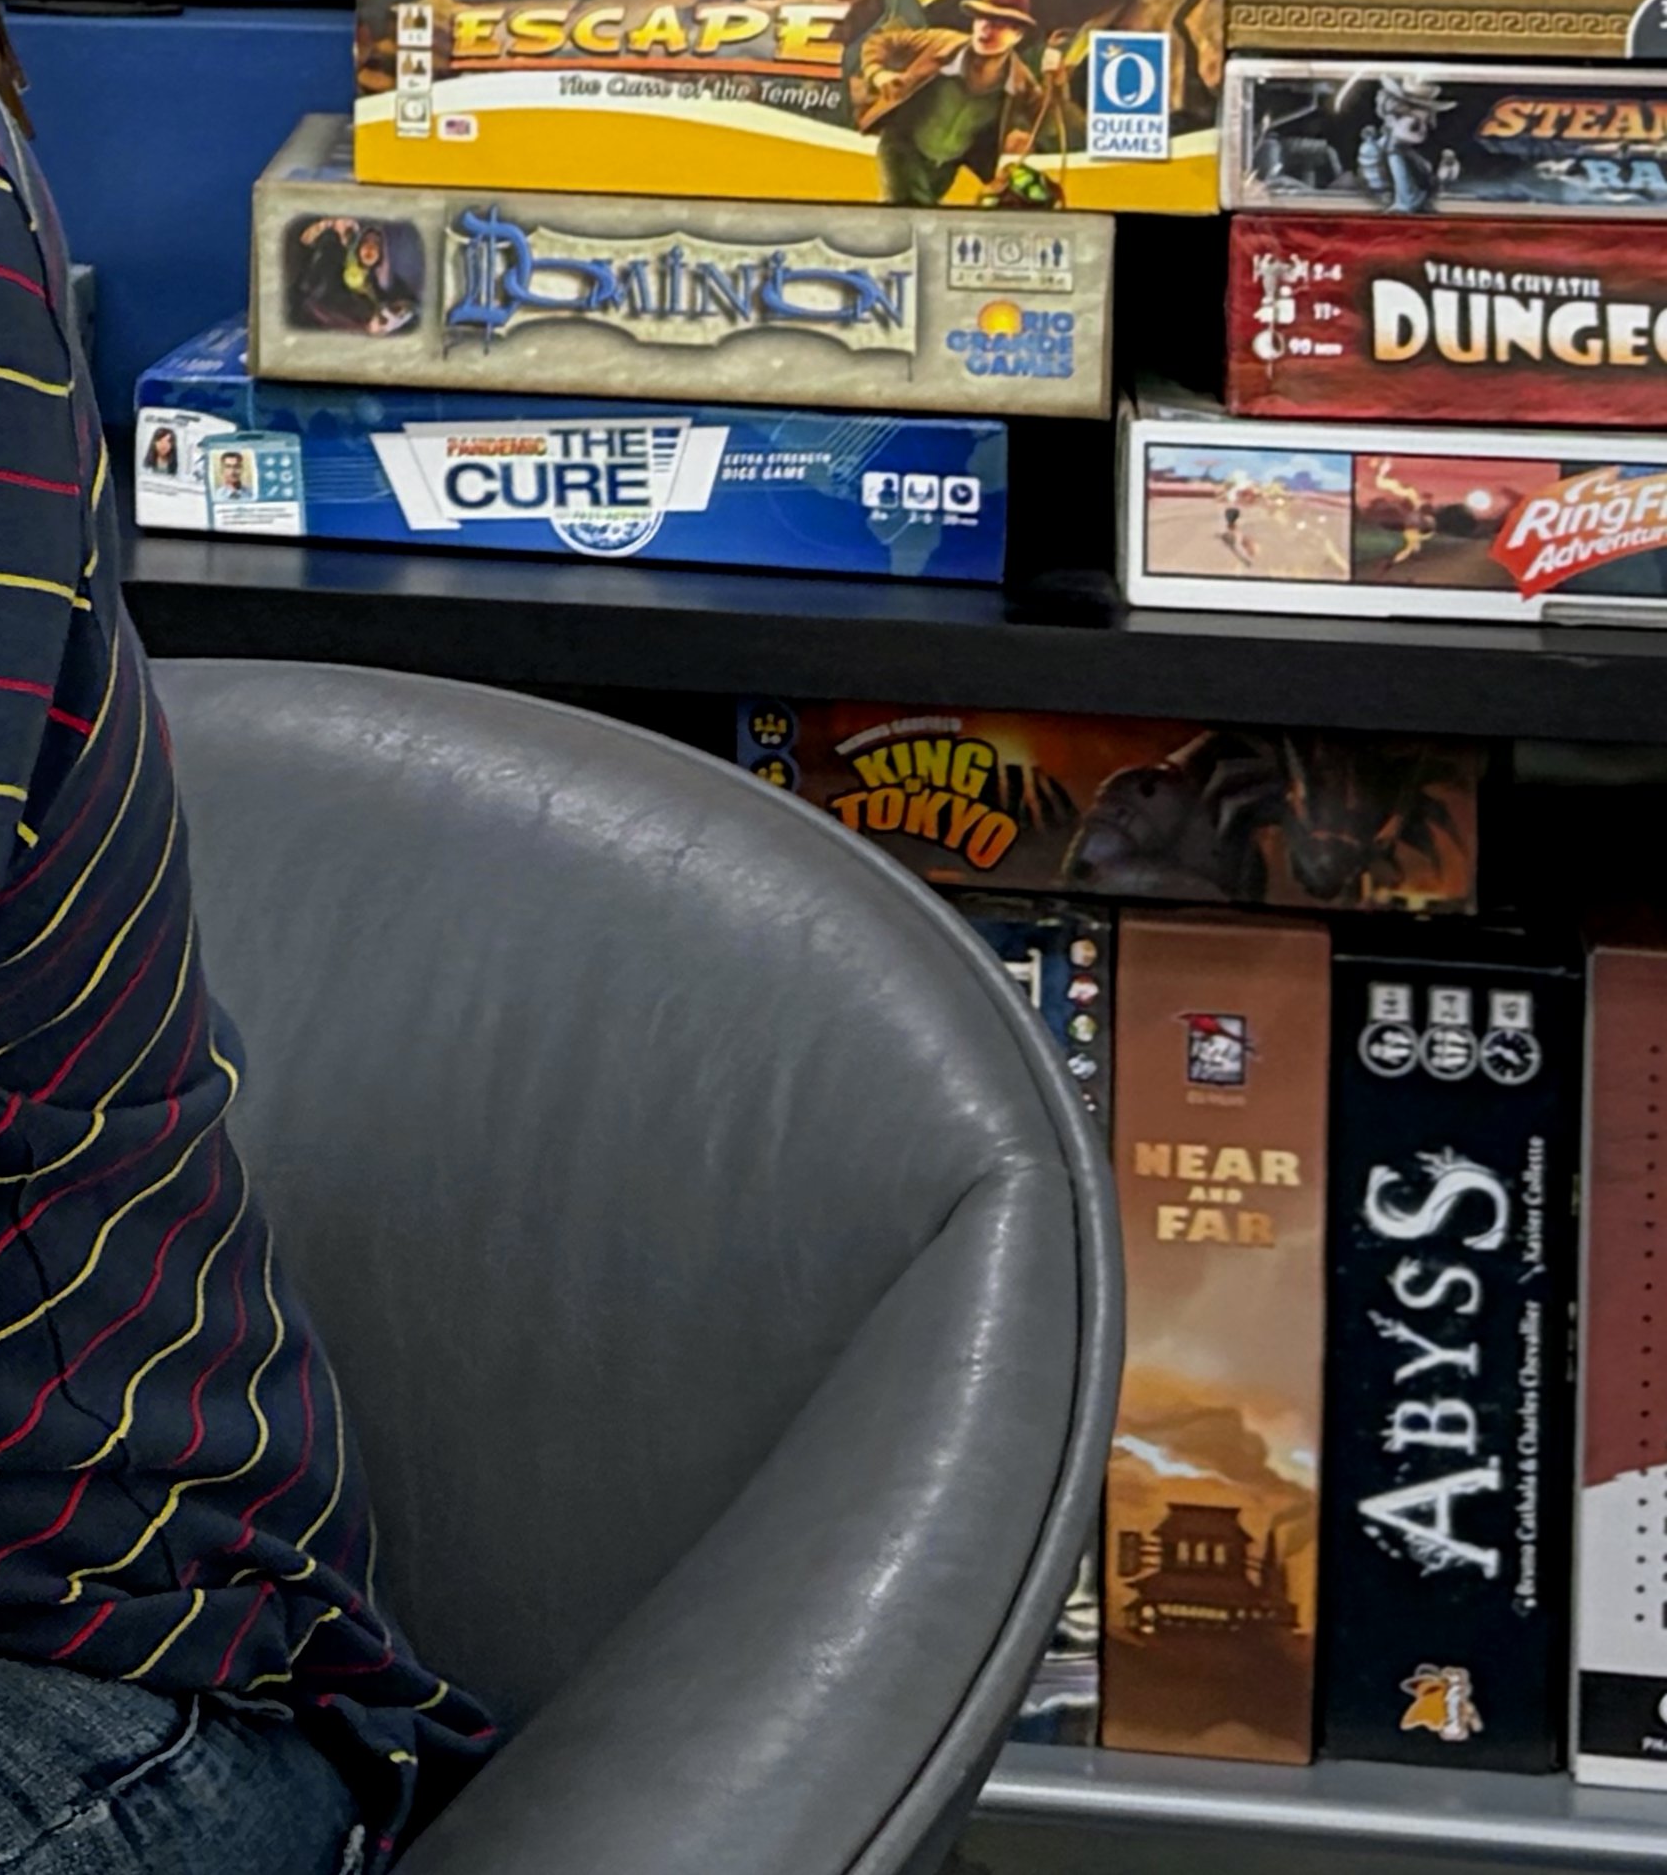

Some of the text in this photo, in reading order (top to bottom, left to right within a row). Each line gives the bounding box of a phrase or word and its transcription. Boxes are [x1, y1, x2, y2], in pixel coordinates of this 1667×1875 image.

[453, 3, 851, 64] ESCAPE
[677, 77, 704, 102] of
[707, 78, 749, 102] the
[759, 81, 841, 111] Temple
[1092, 118, 1164, 135] QUEEN
[1092, 137, 1164, 154] GAMES
[446, 205, 910, 345] DOMINION
[1372, 279, 1667, 366] DUNGE
[445, 427, 649, 458] PANDEMIC THE
[443, 460, 653, 511] CURE
[852, 738, 995, 799] KING
[830, 787, 1018, 869] TOKYO
[1134, 1142, 1301, 1187] NEAR
[1187, 1185, 1244, 1204] AND
[1155, 1204, 1276, 1249] FAR
[1520, 1135, 1546, 1263] Xavier Collette
[1358, 1145, 1512, 1579] ABYSS
[1517, 1300, 1541, 1388] Chevallier
[1516, 1390, 1540, 1456] Charles
[1515, 1474, 1538, 1542] Cathala
[1515, 1543, 1538, 1596] Bruno
